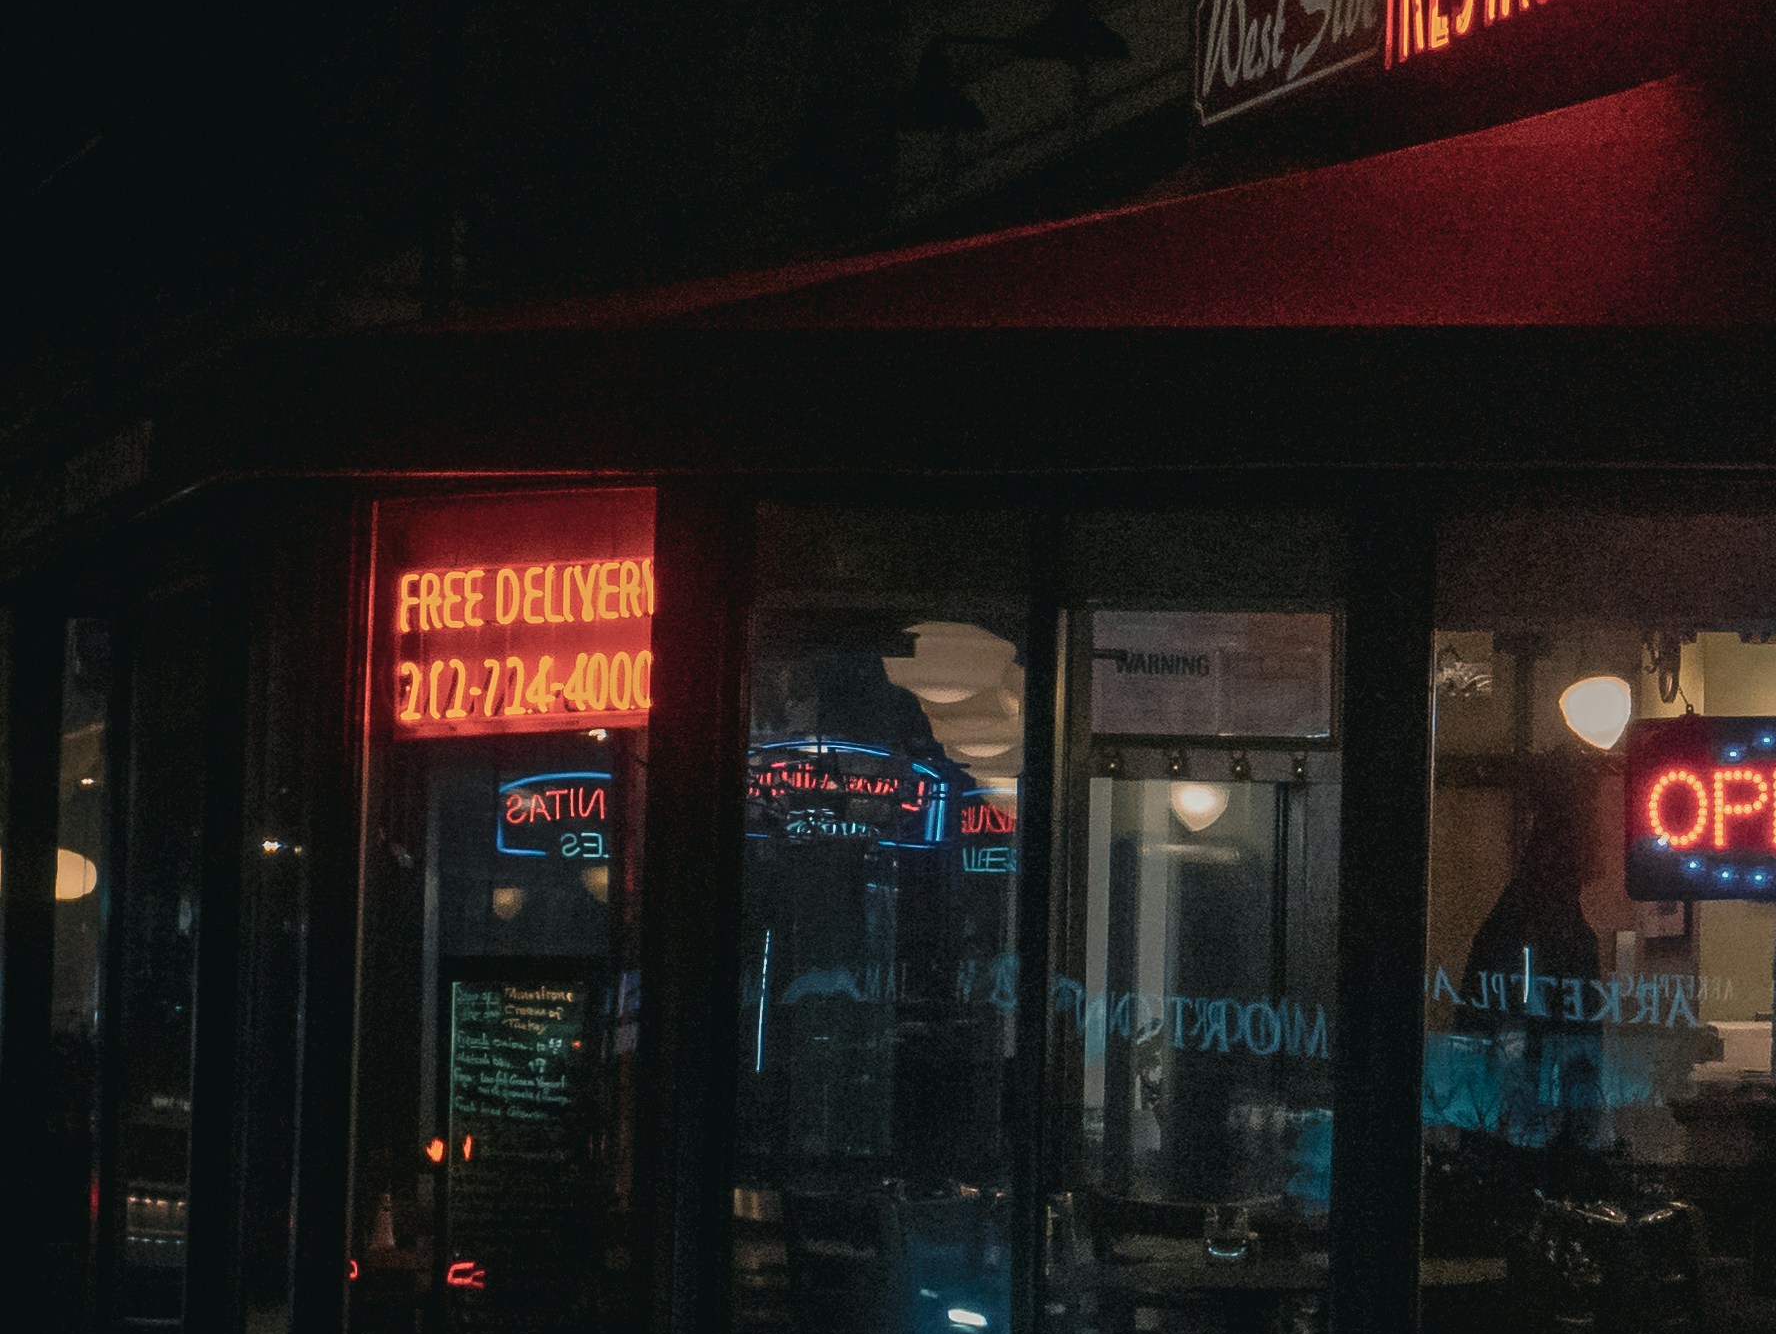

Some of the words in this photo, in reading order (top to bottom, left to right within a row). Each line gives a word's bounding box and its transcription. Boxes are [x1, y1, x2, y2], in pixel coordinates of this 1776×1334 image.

[400, 567, 486, 633] FREE
[400, 650, 652, 720] 212-724-4000
[1114, 650, 1211, 677] WARNING
